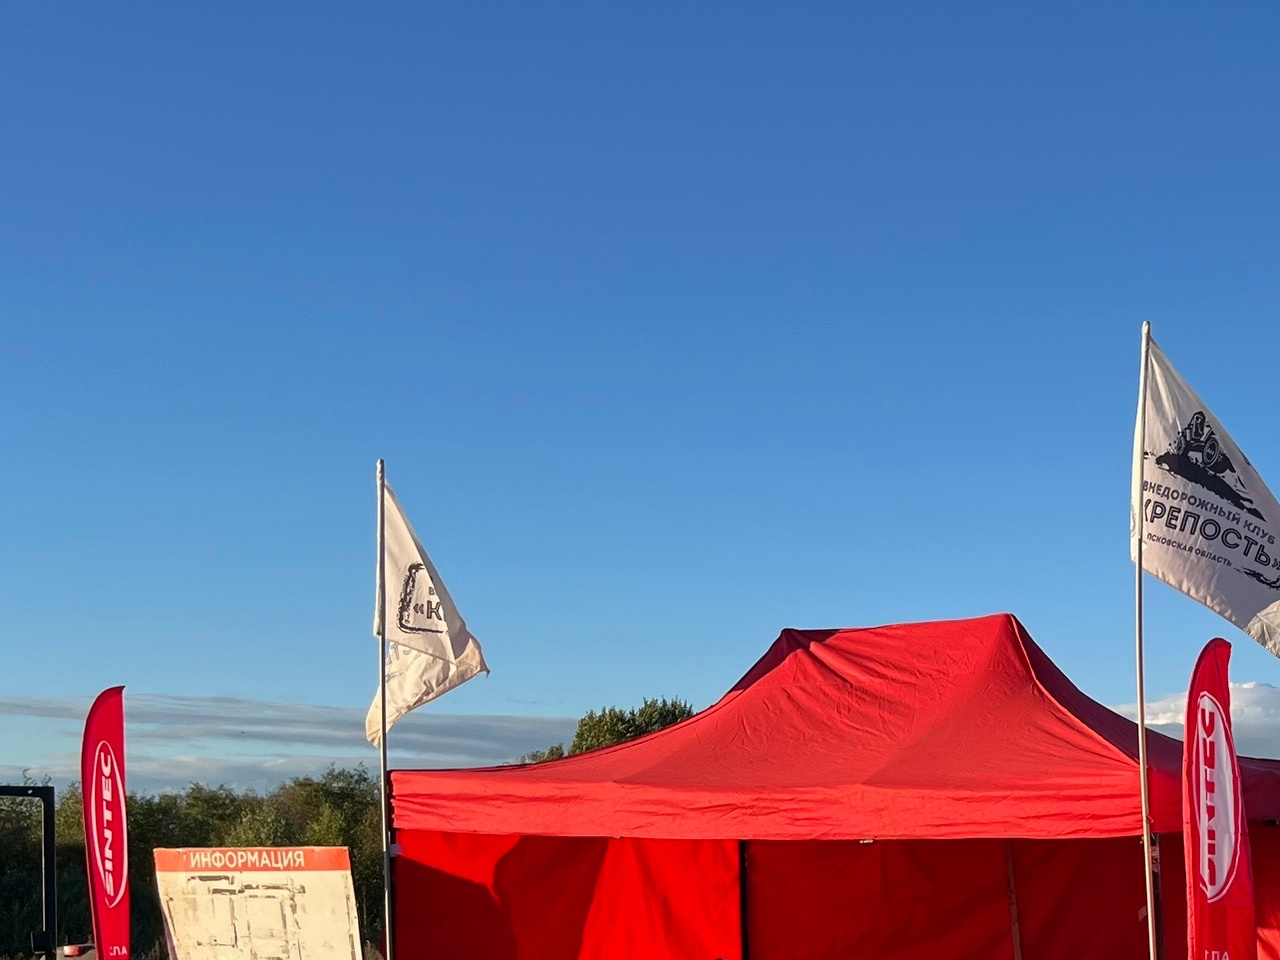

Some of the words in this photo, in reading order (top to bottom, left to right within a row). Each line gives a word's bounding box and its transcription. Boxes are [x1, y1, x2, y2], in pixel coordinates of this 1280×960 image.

[1143, 480, 1241, 525] ВНЕДОРОЖНЫЙ
[1243, 519, 1276, 545] КЛУБ
[1146, 532, 1194, 554] ПСКОВСКАЯ
[1194, 548, 1232, 567] ОБЛАСТЬ
[189, 850, 305, 870] ИНФОРМАЦИЯ
